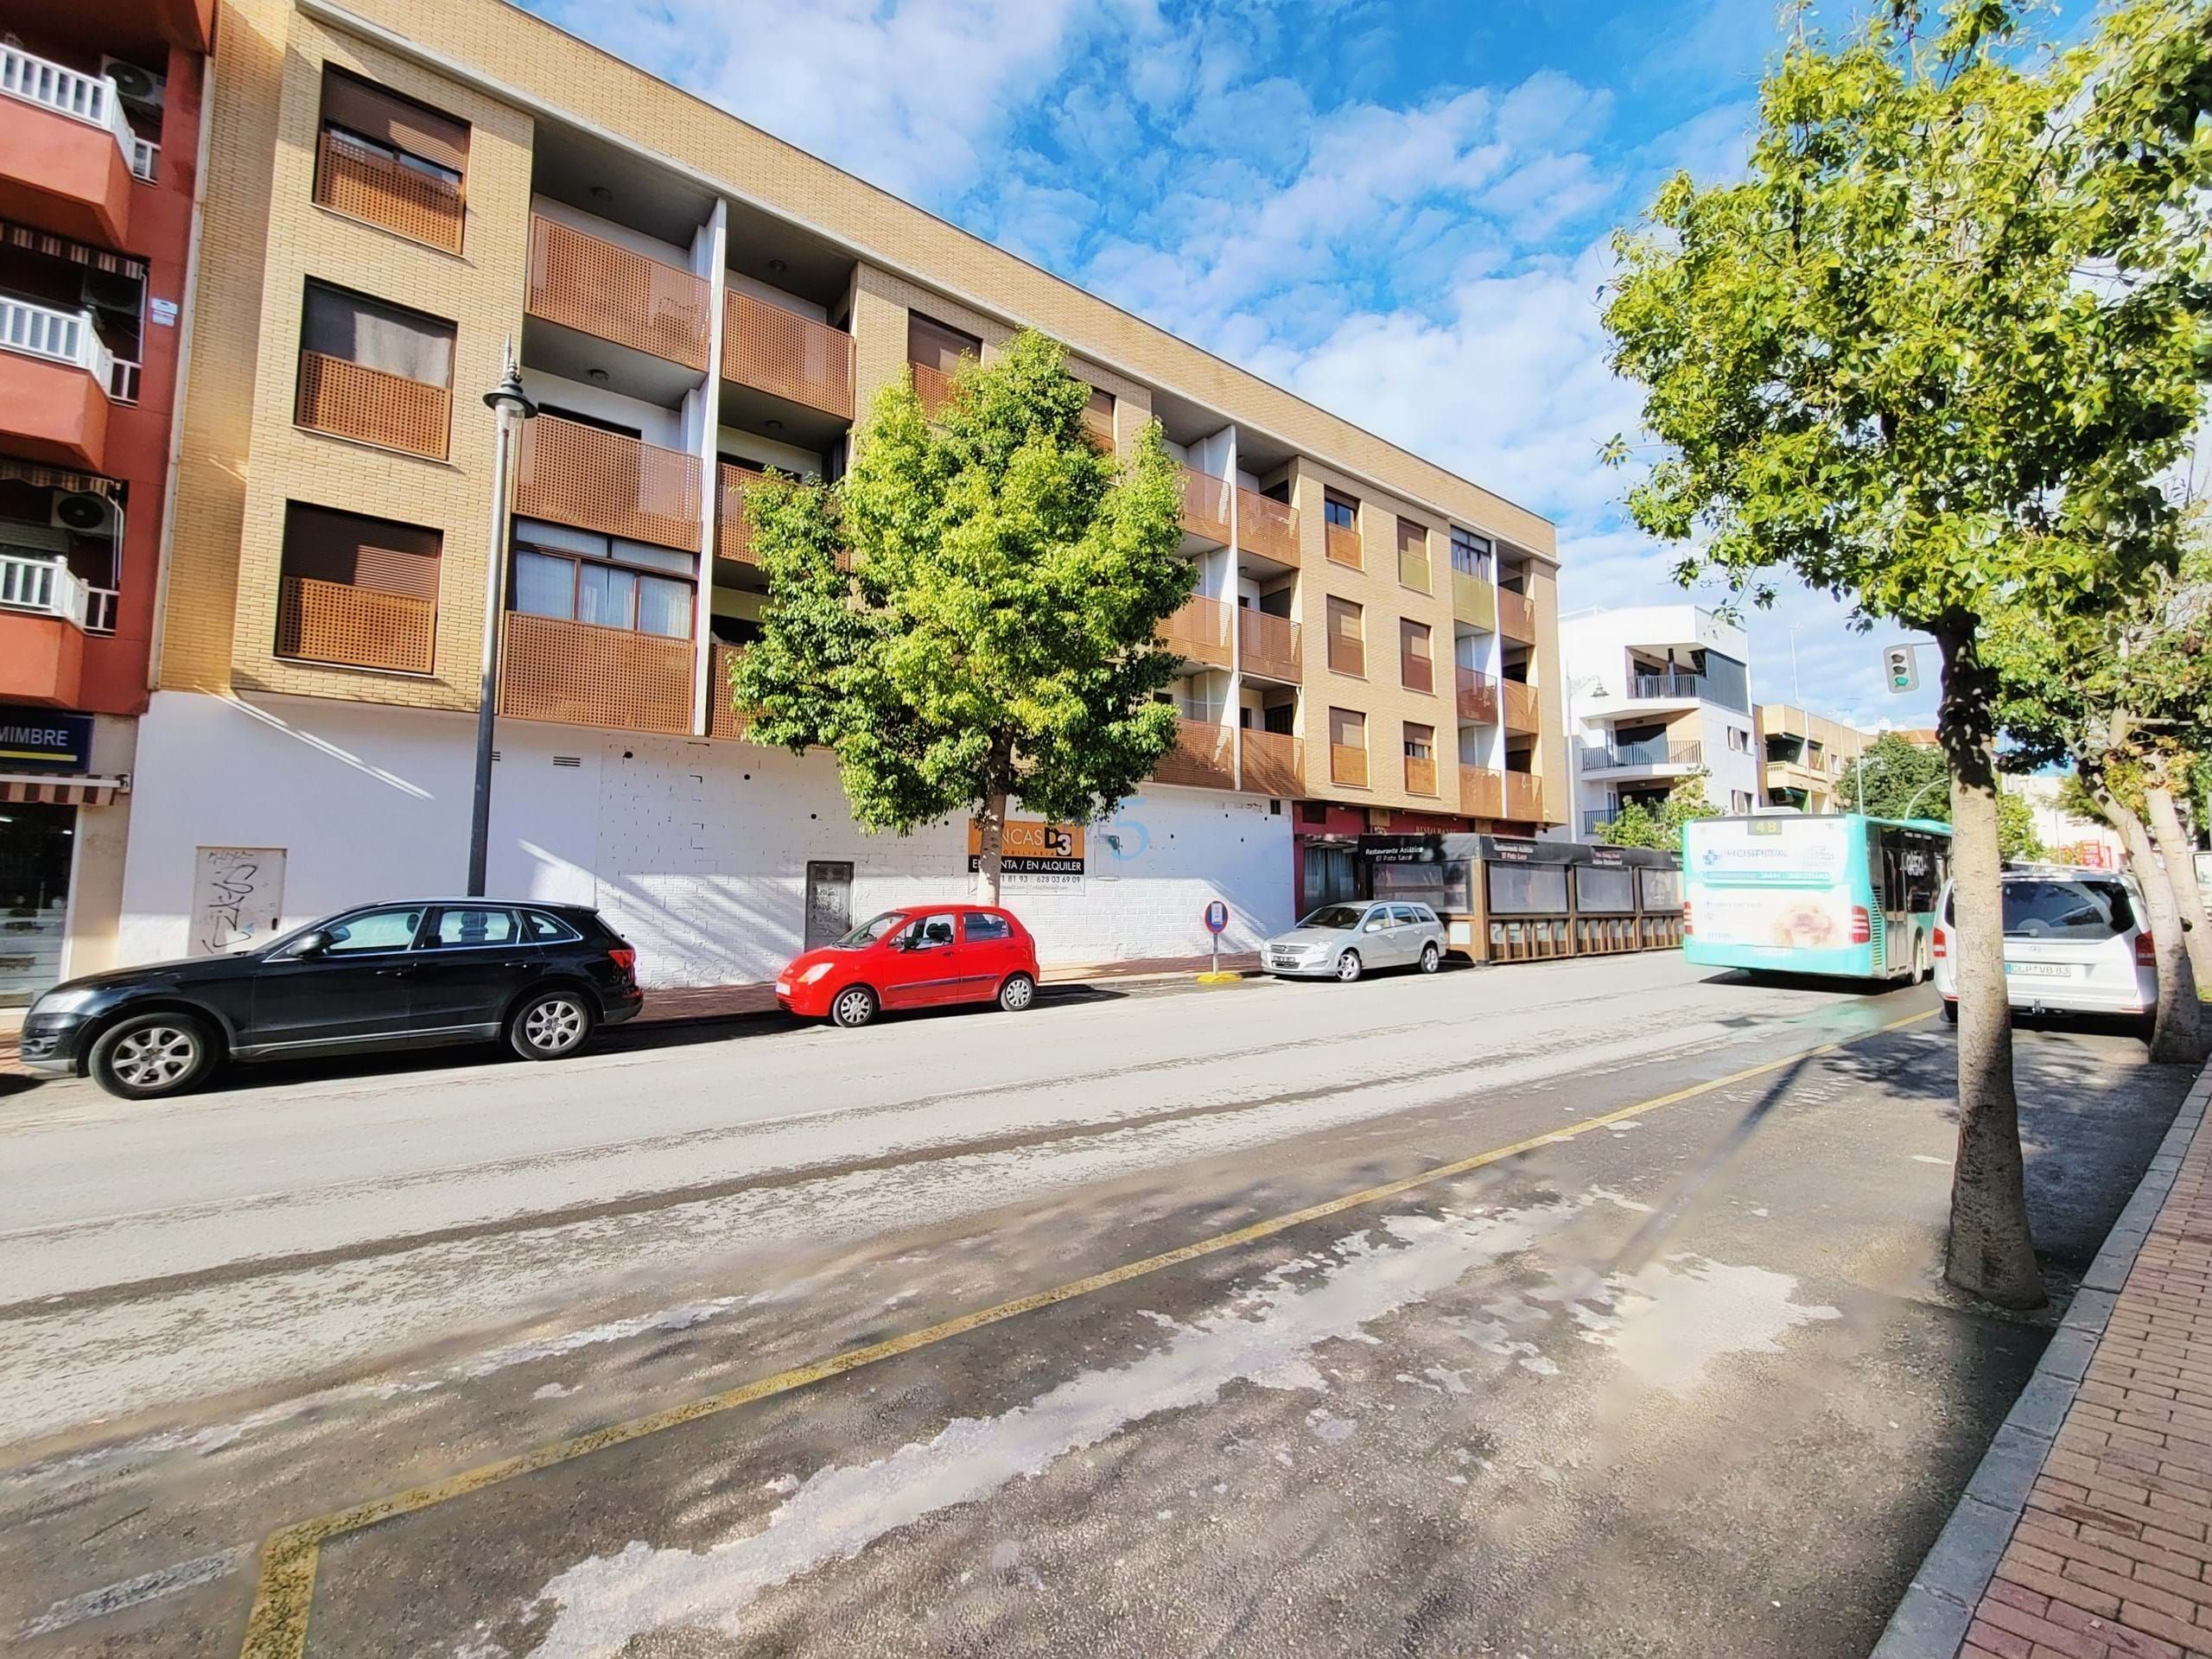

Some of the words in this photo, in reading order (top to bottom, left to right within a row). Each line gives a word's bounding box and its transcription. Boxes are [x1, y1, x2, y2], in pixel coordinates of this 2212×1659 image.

[0, 726, 69, 747] MIMBRE
[1027, 860, 1039, 870] EN
[1040, 861, 1082, 872] ALQUILER
